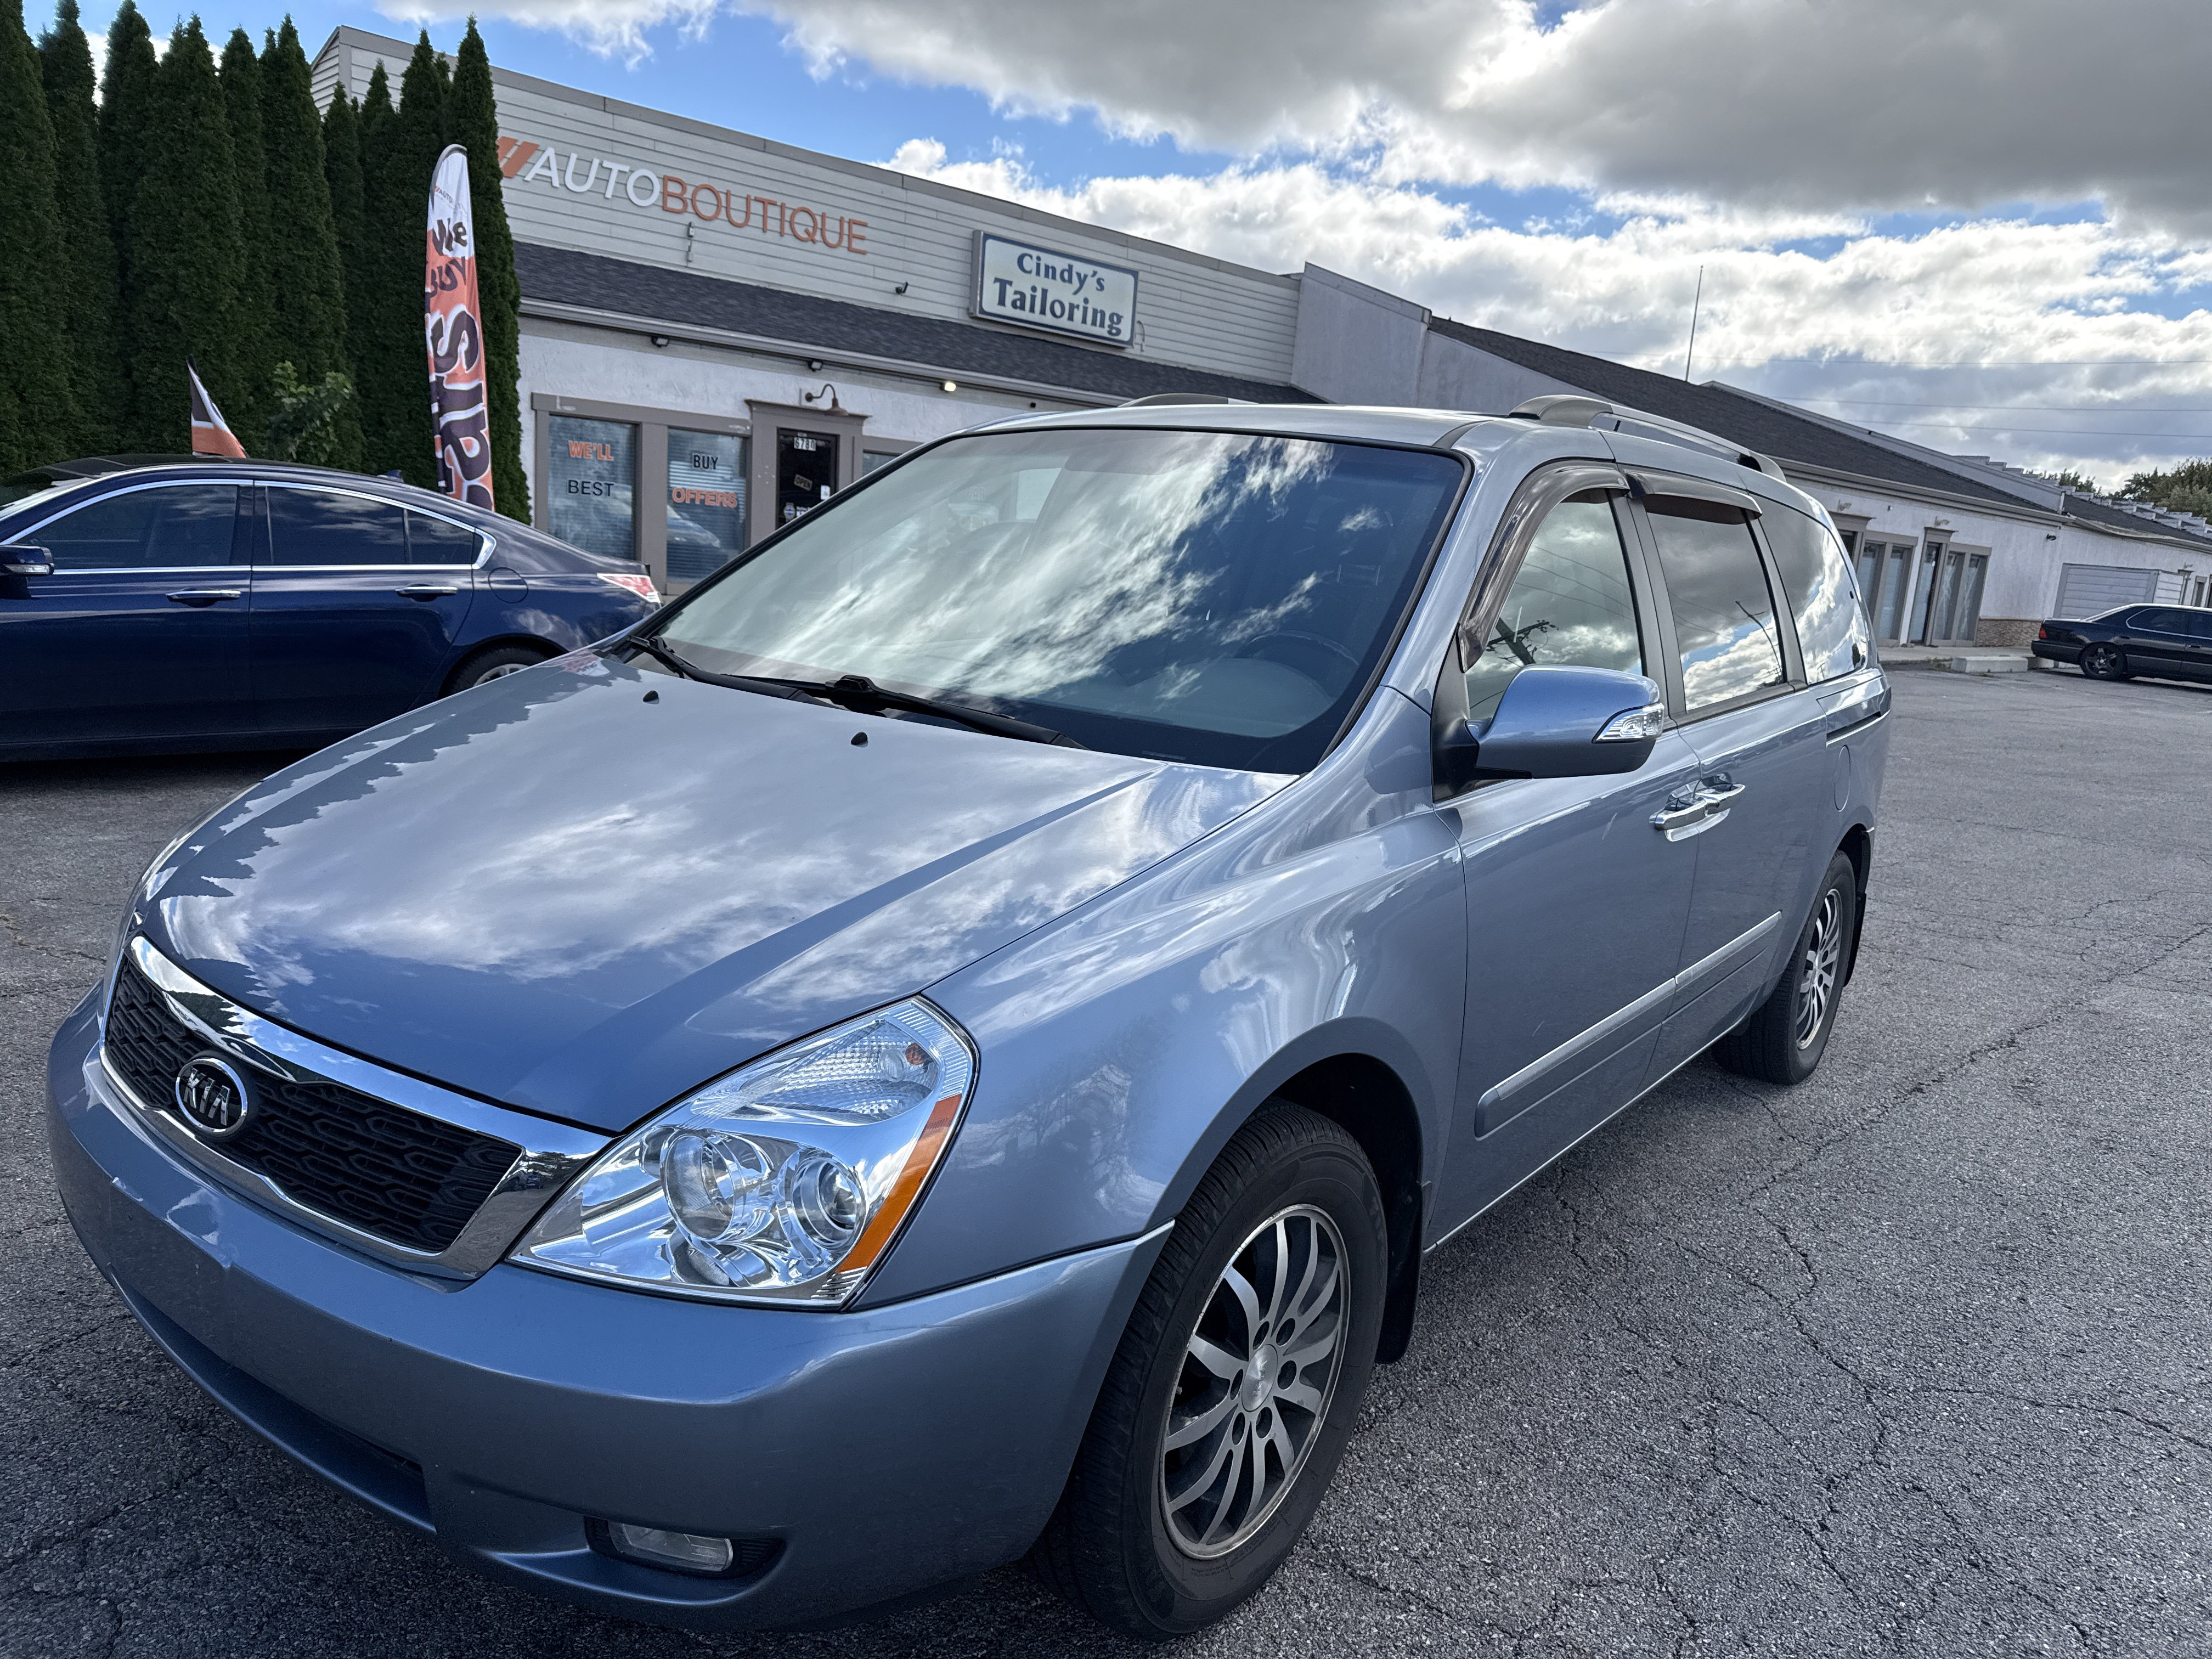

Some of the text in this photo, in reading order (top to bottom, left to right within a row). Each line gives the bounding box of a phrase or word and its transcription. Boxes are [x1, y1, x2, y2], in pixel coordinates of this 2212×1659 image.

[1017, 252, 1105, 295] Cindy's
[993, 277, 1124, 336] Tailoring
[568, 440, 614, 461] WE'LL
[692, 453, 719, 470] BUY
[567, 479, 614, 497] BEST
[795, 476, 811, 488] OPEN
[672, 487, 738, 508] OFFERS
[183, 1068, 231, 1126] KIA
